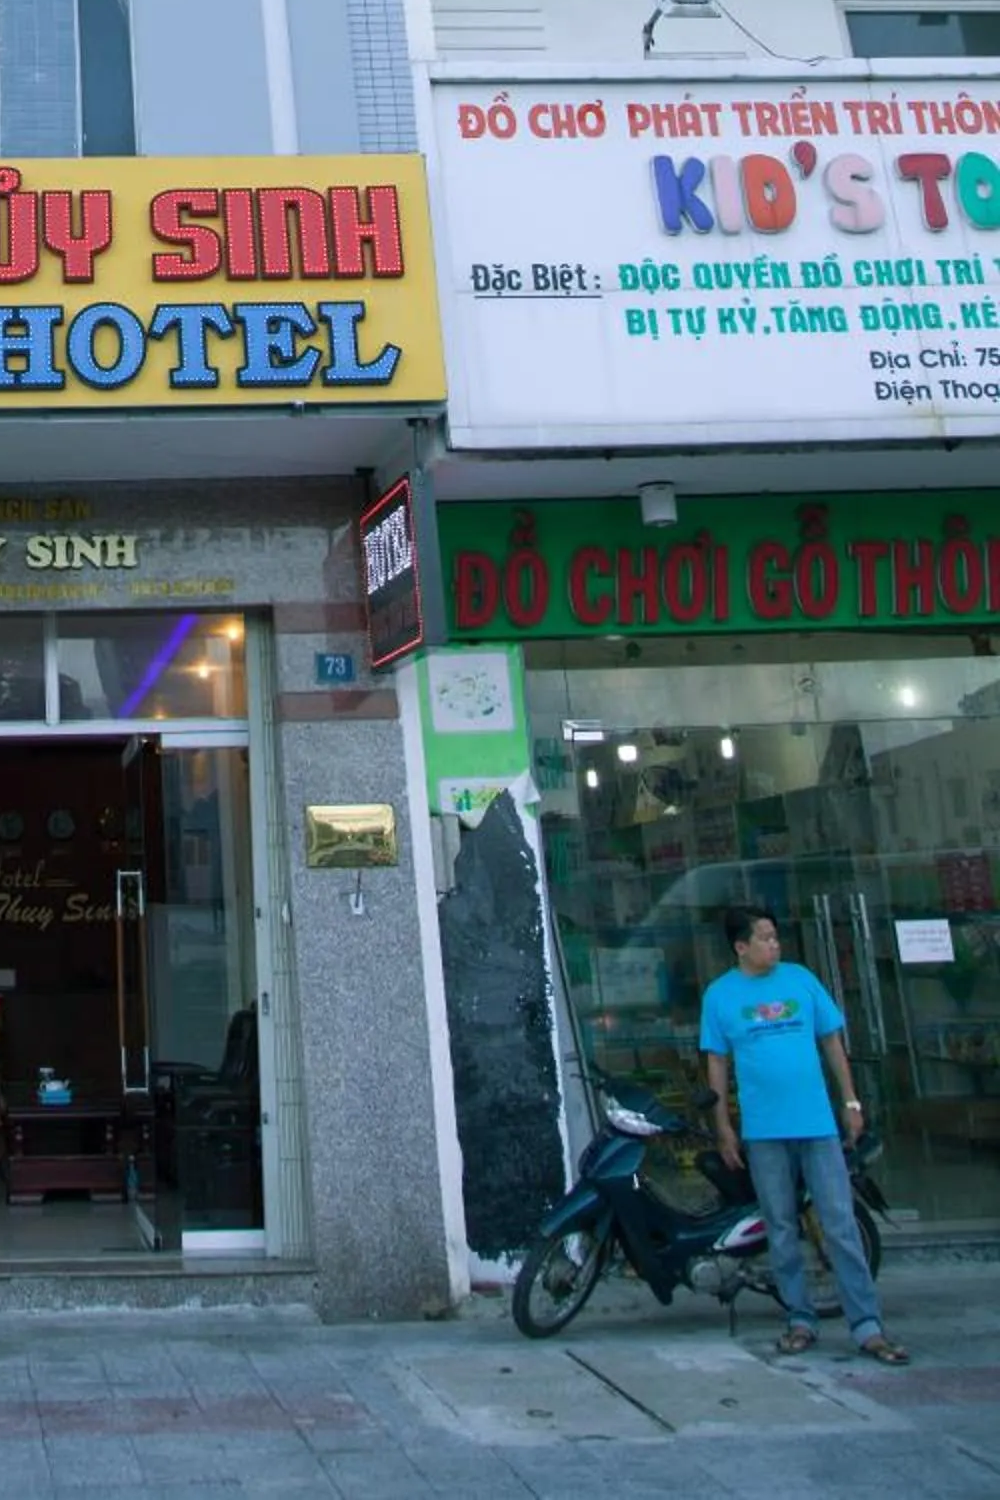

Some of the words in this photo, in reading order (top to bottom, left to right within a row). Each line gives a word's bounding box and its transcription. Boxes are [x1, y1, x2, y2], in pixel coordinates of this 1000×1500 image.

[625, 92, 722, 138] PHÁT
[731, 85, 839, 137] TRIỂN
[843, 92, 904, 136] TRÍ
[650, 141, 886, 236] KID'S
[150, 185, 405, 281] SINH
[471, 263, 523, 295] Đặc
[618, 257, 681, 295] ĐỘC
[852, 257, 927, 288] CHƠI
[935, 252, 985, 286] TRÍ
[624, 307, 660, 341] BỊ
[666, 306, 707, 341] TỰ
[869, 350, 911, 374] Địa
[875, 380, 933, 405] Điện
[25, 534, 140, 570] SINH
[566, 529, 730, 627] CHƠI
[746, 503, 840, 621] GỖ
[324, 656, 347, 676] 73
